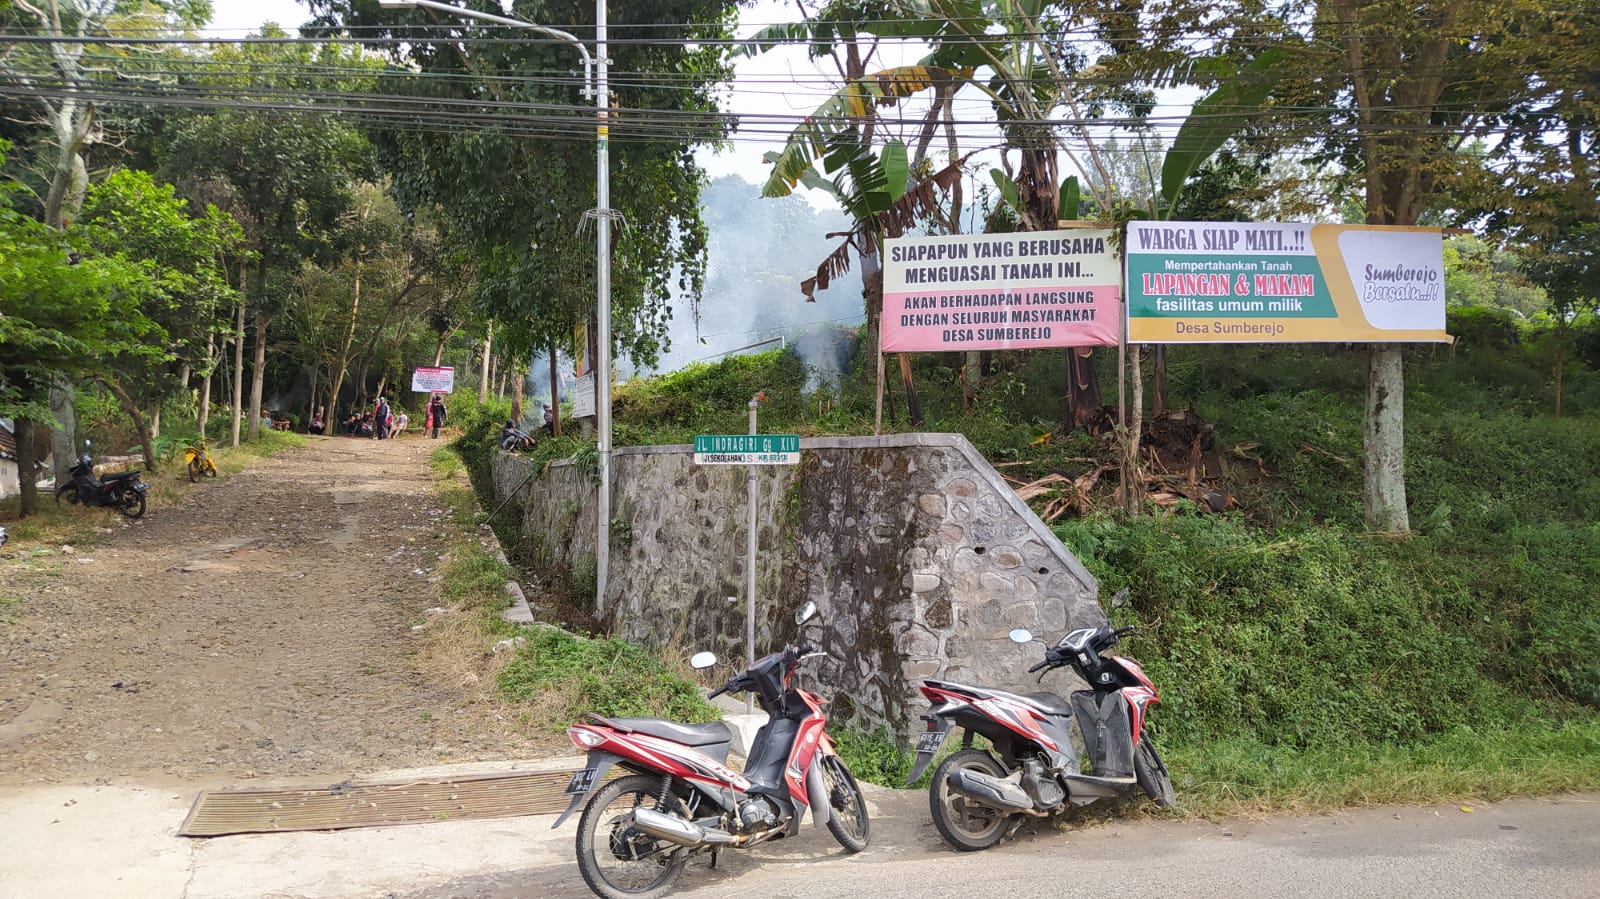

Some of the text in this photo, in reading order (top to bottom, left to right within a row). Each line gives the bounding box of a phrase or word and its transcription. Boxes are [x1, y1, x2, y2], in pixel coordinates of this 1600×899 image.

[892, 237, 1105, 261] SIAPAPUN YANG BERUSAHA
[1138, 228, 1304, 251] WARGA SIAP MATI..!!
[905, 261, 1094, 284] MENGUASAI TANAH INI...
[1165, 260, 1292, 272] Mempertahankan Tanah
[1364, 263, 1437, 284] Sumberejo
[1142, 273, 1315, 296] LAPANGAN & MAKAM
[904, 291, 1094, 310] AKAN BERHADAPAN LANGSUNG
[1156, 299, 1303, 312] fasilitas umum milik
[900, 308, 1096, 327] DENGAN SELURUH MASYARAKAT
[942, 326, 1051, 342] DESA SUMBEREJO
[1176, 322, 1284, 335] Desa Sumberejo
[711, 437, 757, 451] INDRAGIRI
[780, 437, 796, 451] XIV
